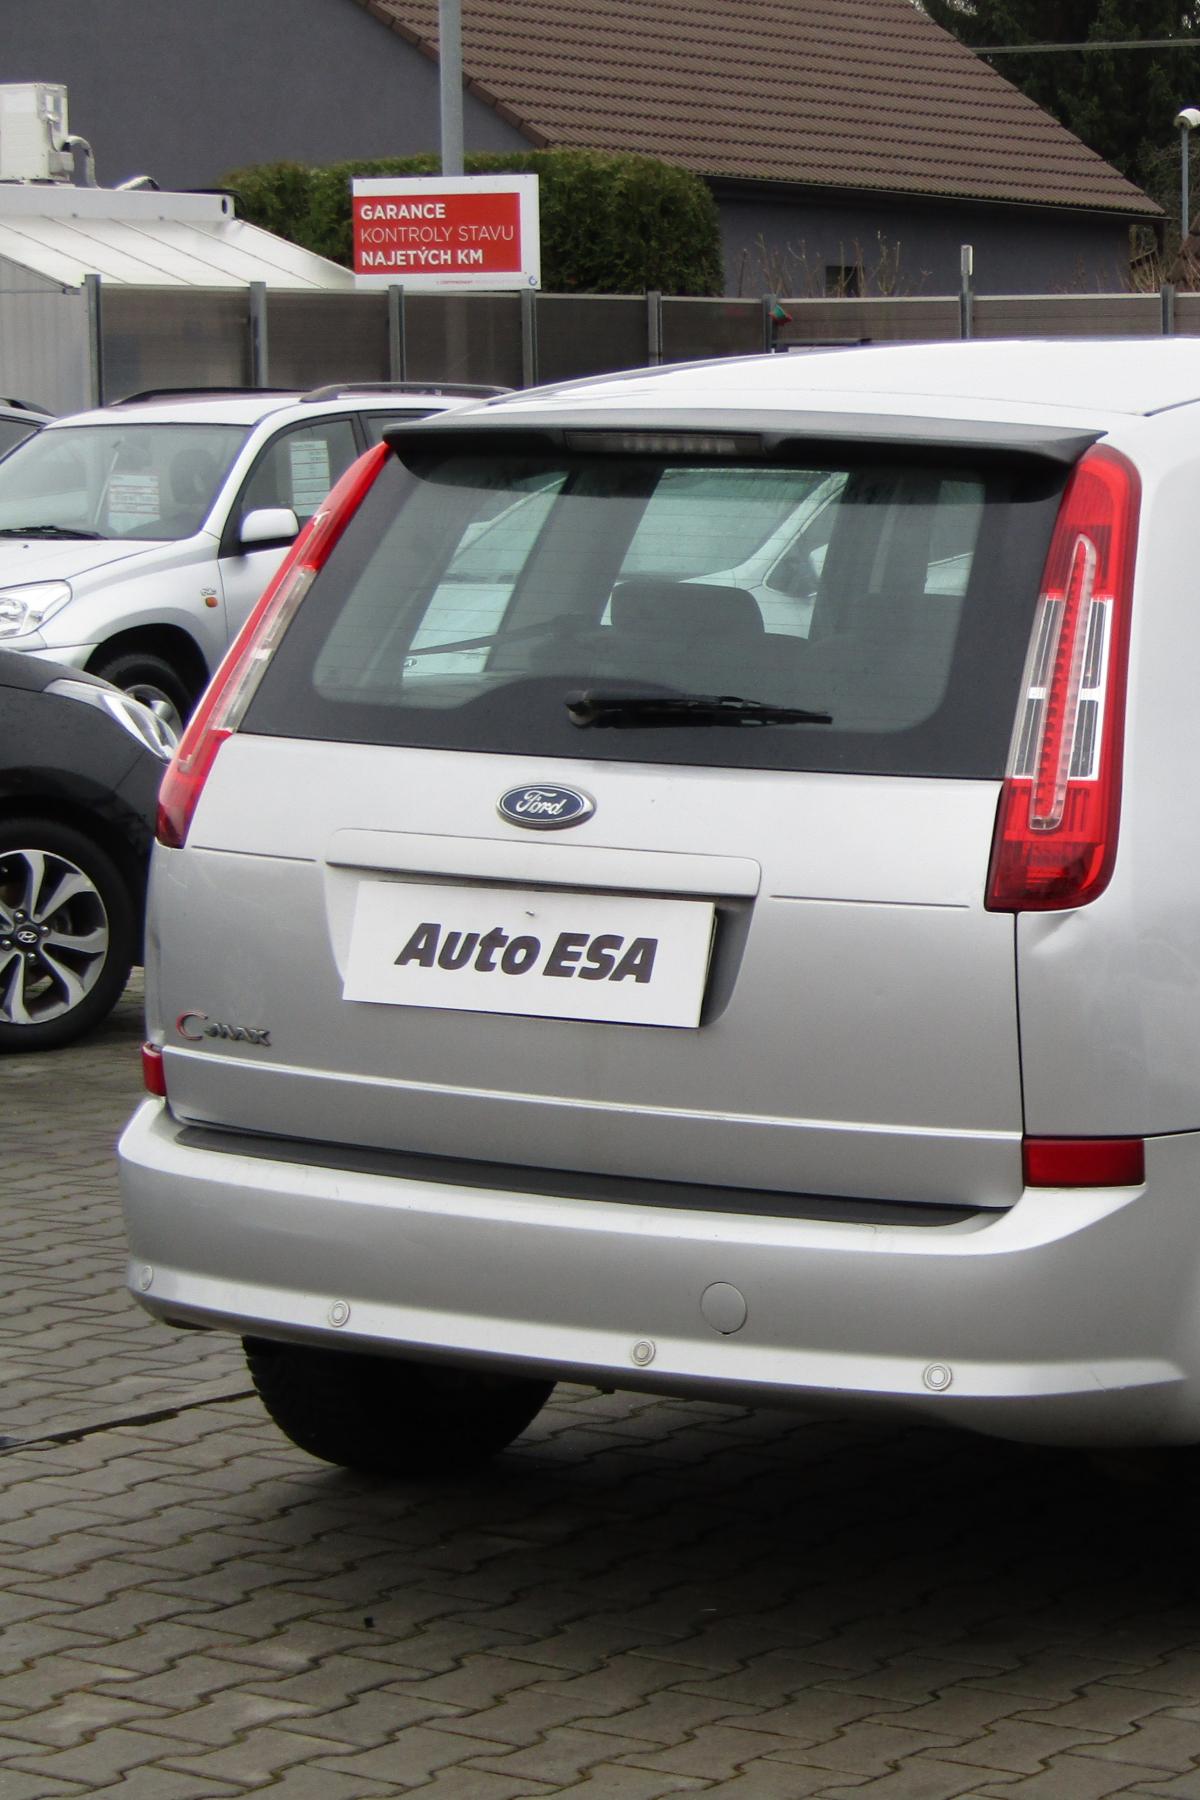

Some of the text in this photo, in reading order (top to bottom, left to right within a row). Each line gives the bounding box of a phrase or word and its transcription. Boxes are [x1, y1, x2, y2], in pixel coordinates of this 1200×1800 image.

[360, 203, 446, 220] GARANCE
[361, 225, 514, 243] KONTROLY STAVU
[361, 246, 483, 266] NAJETÝCH KM
[516, 790, 567, 815] Ford
[394, 922, 658, 984] Auto ESA
